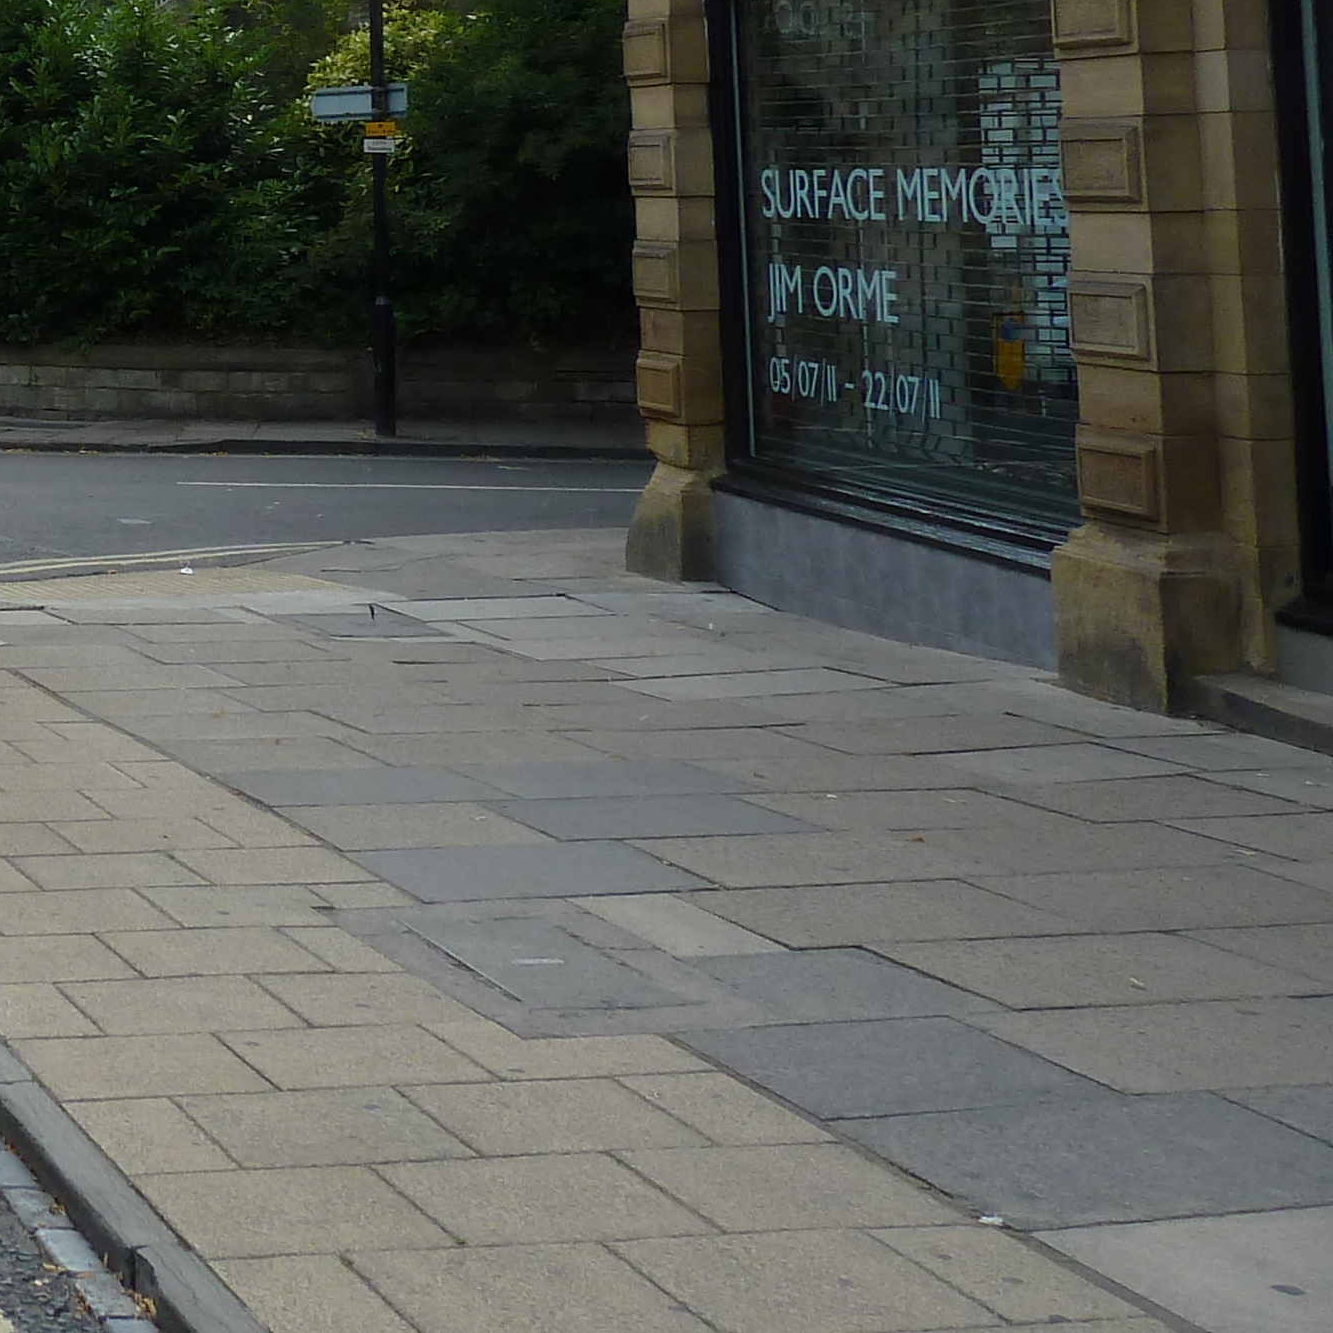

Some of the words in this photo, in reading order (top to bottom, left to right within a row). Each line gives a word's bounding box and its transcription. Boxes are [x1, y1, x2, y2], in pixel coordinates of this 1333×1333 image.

[760, 168, 886, 221] SURFACE
[768, 263, 803, 323] JIM
[813, 265, 899, 323] ORME
